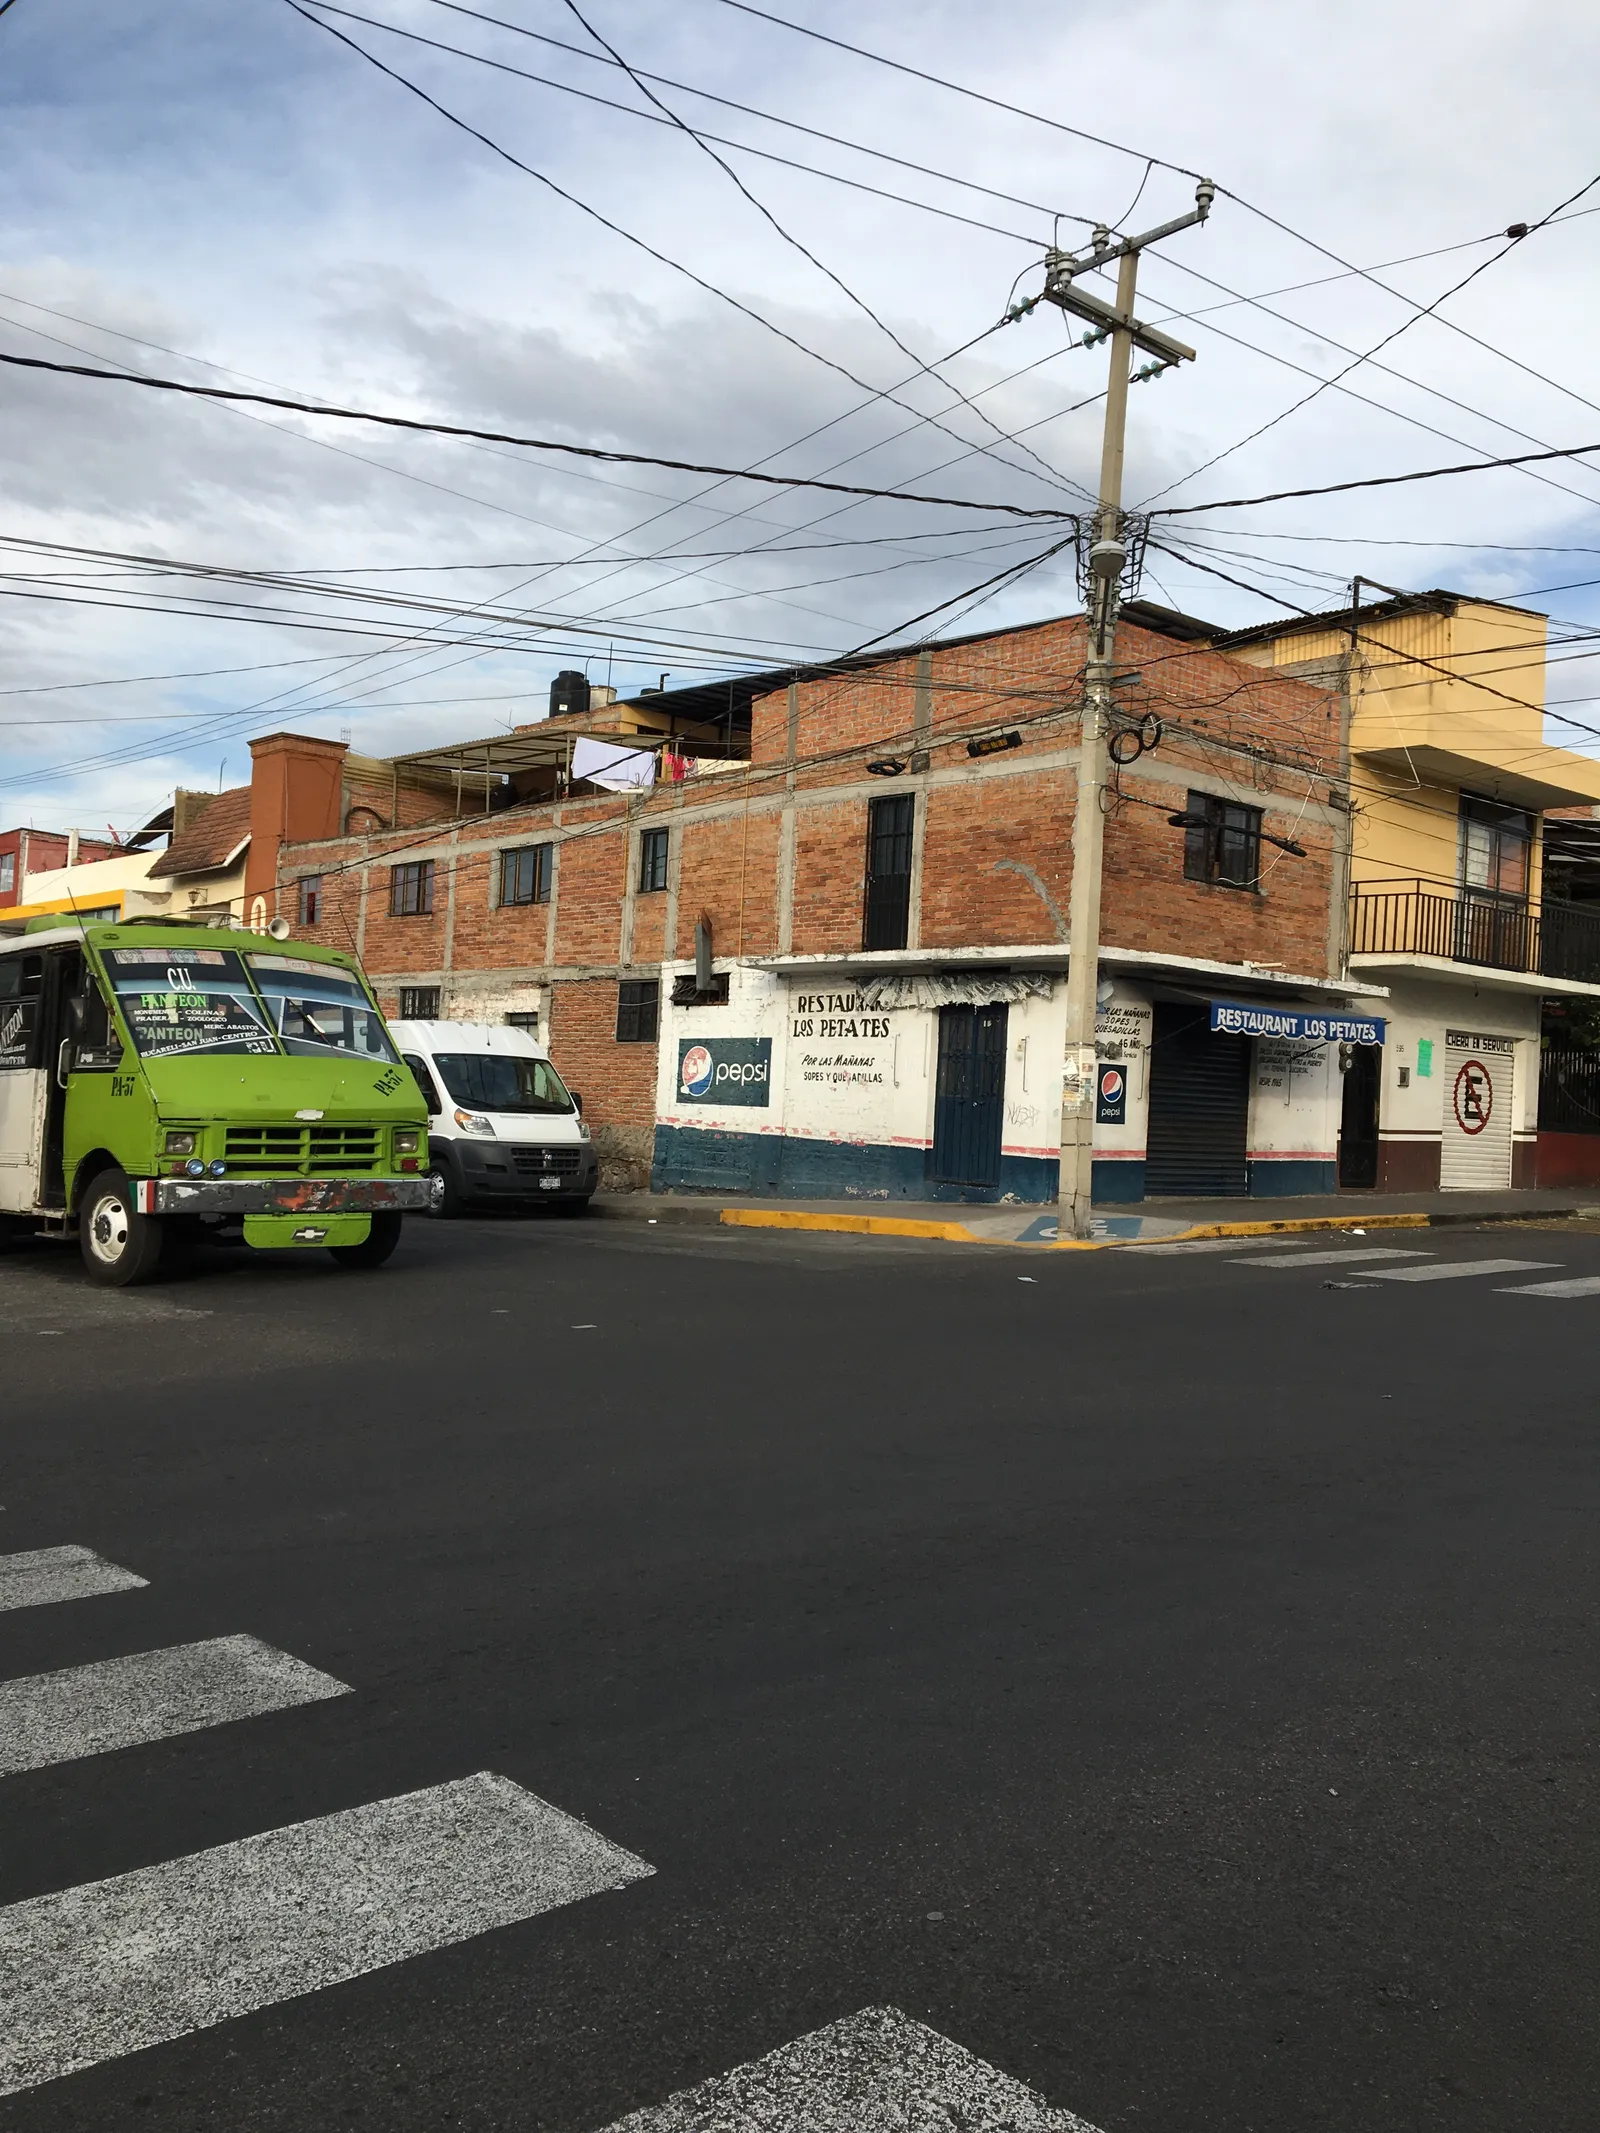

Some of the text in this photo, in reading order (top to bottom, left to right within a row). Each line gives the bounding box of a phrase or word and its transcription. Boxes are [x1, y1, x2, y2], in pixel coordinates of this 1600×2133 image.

[167, 967, 196, 991] C.U.
[140, 994, 207, 1008] PANTEON
[793, 1018, 890, 1037] LOS PETATES
[1105, 1016, 1140, 1027] SOPES Y
[1217, 1008, 1376, 1040] RESTAURANT LOS PETATES
[1095, 1025, 1140, 1036] QUESADILLAS
[1482, 1038, 1514, 1053] SERVICIO
[716, 1059, 767, 1086] pepsi
[804, 1072, 883, 1083] SOPES Y QUEADILLAS
[111, 1077, 135, 1096] PA-57
[372, 1069, 404, 1097] PA-57
[1101, 1107, 1121, 1117] pepsi
